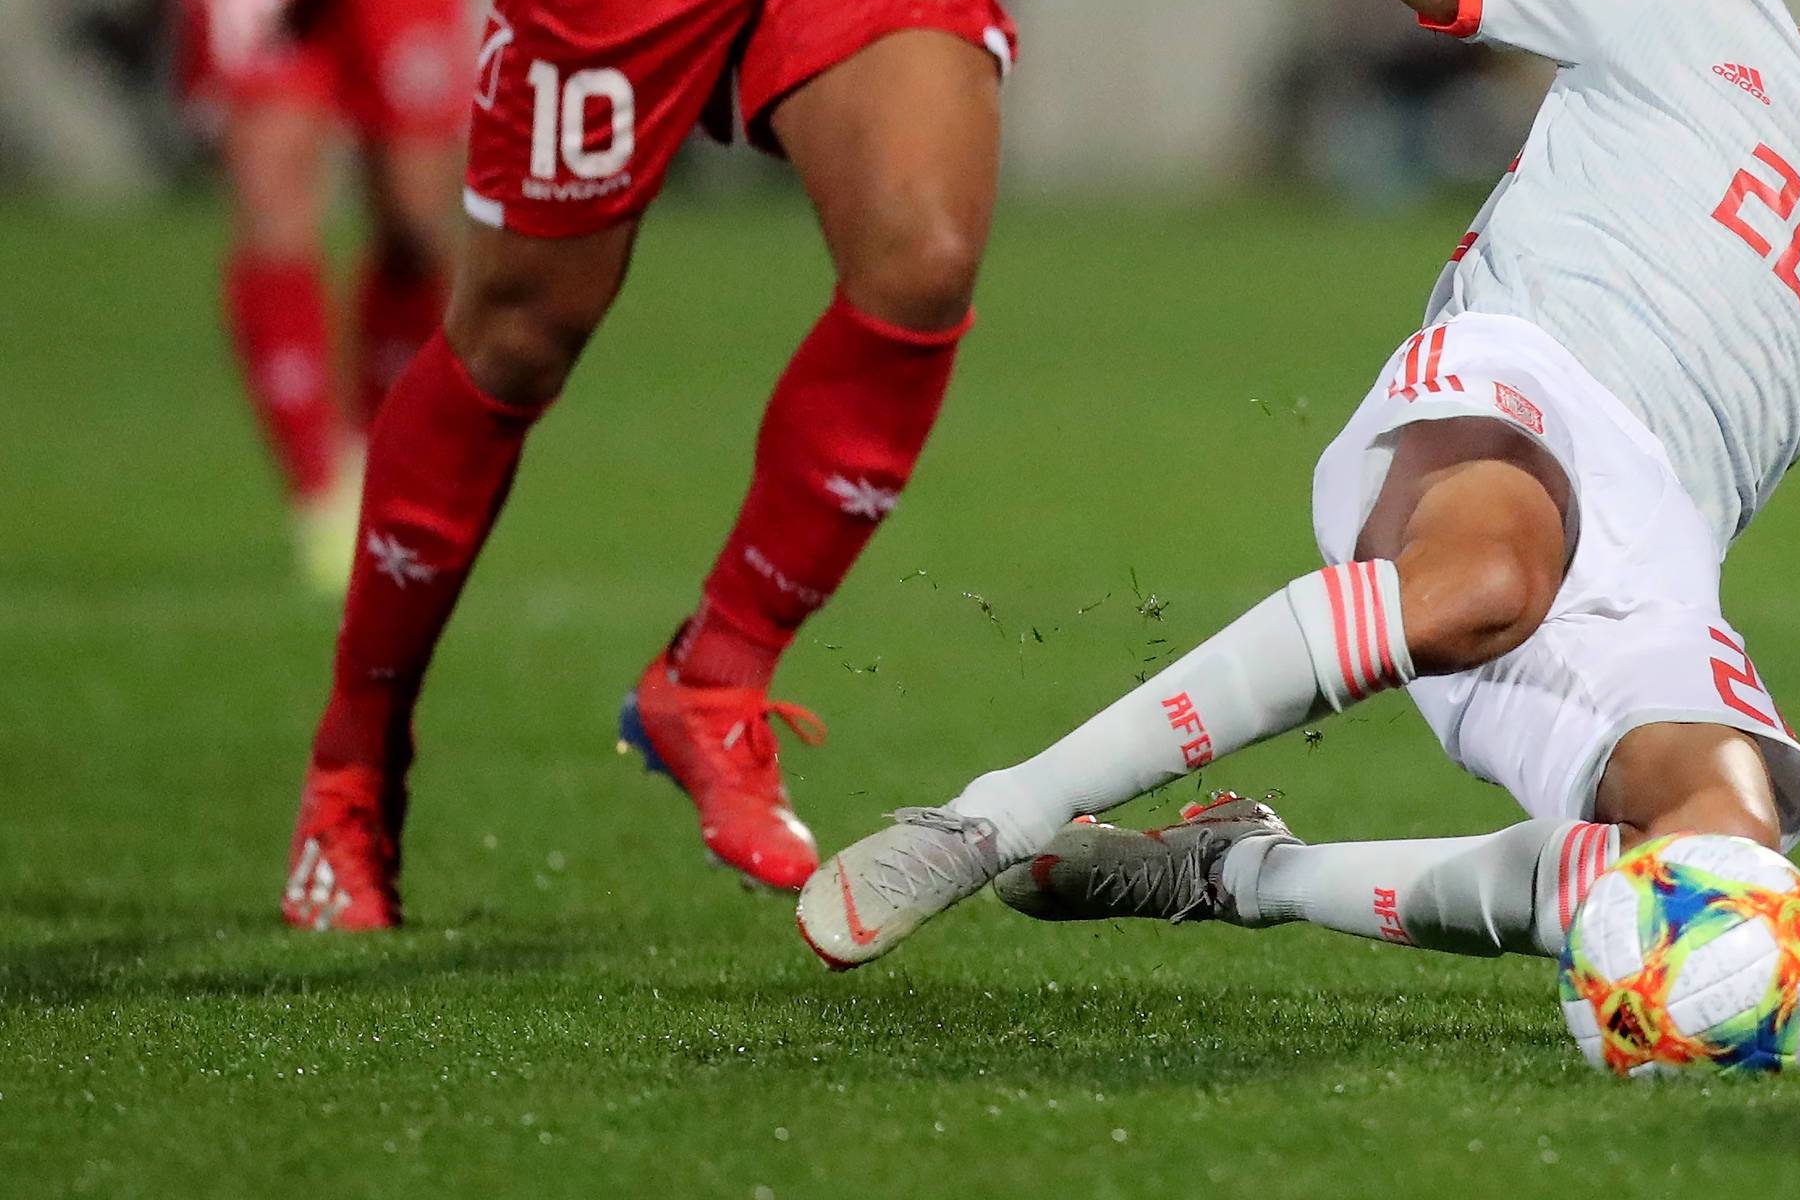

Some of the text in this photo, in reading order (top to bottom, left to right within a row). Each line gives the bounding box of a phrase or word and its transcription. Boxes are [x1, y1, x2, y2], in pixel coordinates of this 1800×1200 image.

[526, 59, 636, 180] 10
[1711, 64, 1772, 106] adidas
[1708, 626, 1798, 738] 2
